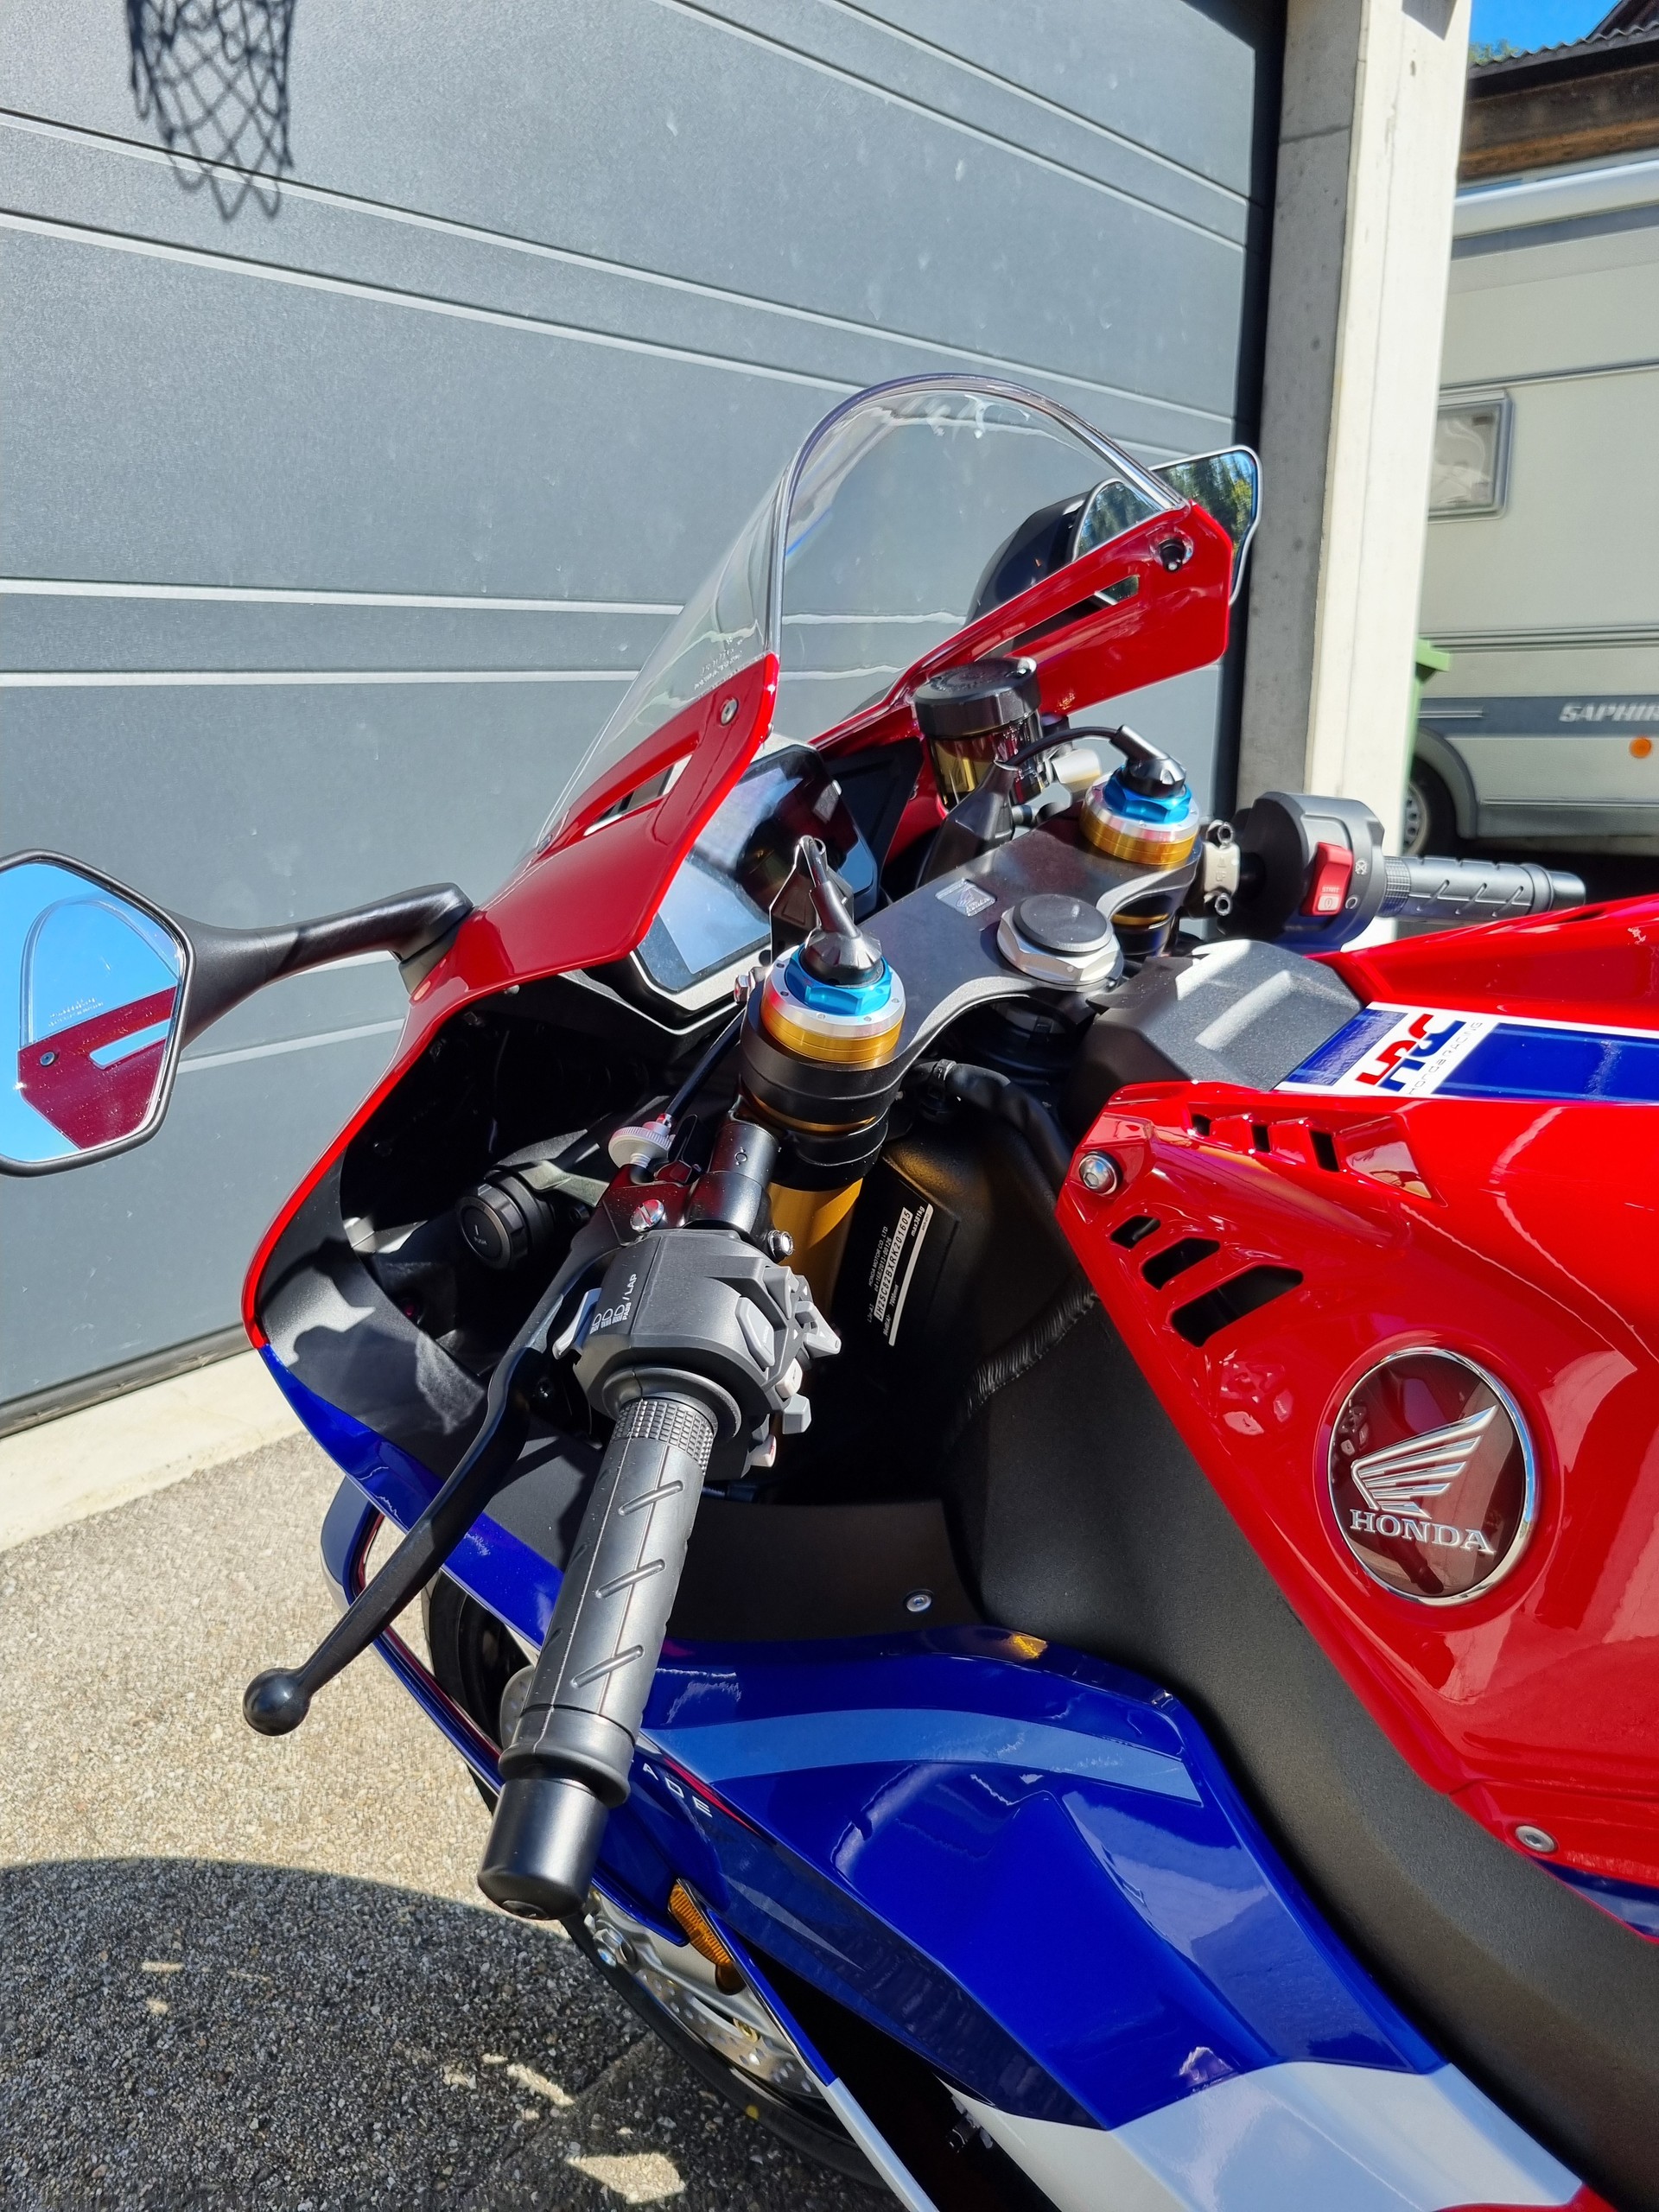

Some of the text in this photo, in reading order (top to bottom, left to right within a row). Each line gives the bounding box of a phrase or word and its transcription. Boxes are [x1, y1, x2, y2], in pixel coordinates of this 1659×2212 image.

[1356, 1014, 1466, 1091] HRC
[872, 1248, 880, 1268] MOTOR
[875, 1211, 912, 1319] JH2SC82BXRK201605
[625, 1274, 637, 1295] LAP
[1349, 1510, 1496, 1554] HONDA
[632, 1760, 713, 1817] ADE
